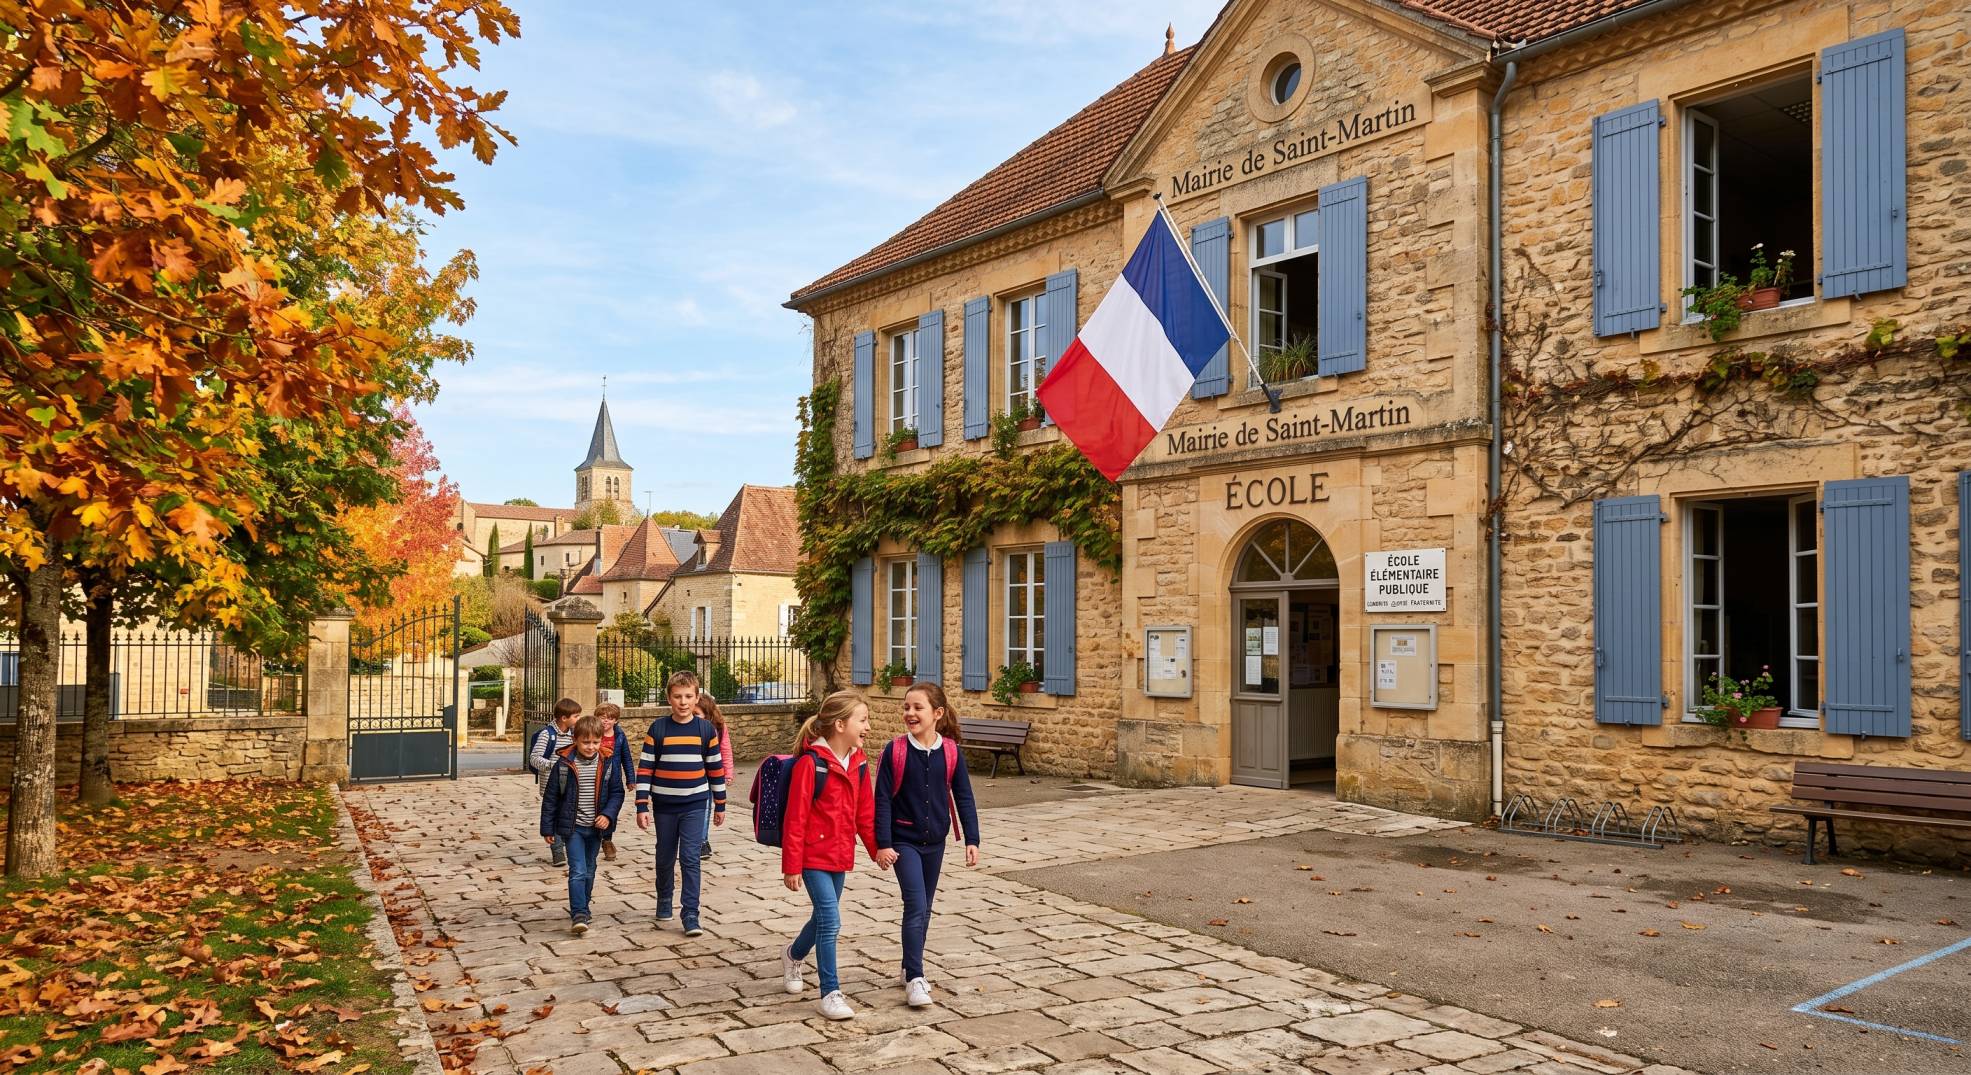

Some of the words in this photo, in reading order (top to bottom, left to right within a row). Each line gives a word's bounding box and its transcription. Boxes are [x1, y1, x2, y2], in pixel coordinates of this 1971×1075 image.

[1171, 161, 1233, 198] Mairie
[1241, 151, 1265, 174] de
[1273, 100, 1416, 166] Saint-Martin
[1167, 426, 1228, 455] Mairie
[1235, 422, 1259, 446] de
[1266, 400, 1410, 442] Saint-Martin
[1225, 472, 1330, 510] ÉCOLE
[1388, 554, 1420, 567] ÉCOLE
[1370, 568, 1439, 581] ÉLÉMENTAIRE
[1379, 583, 1429, 595] PUBLIQUE
